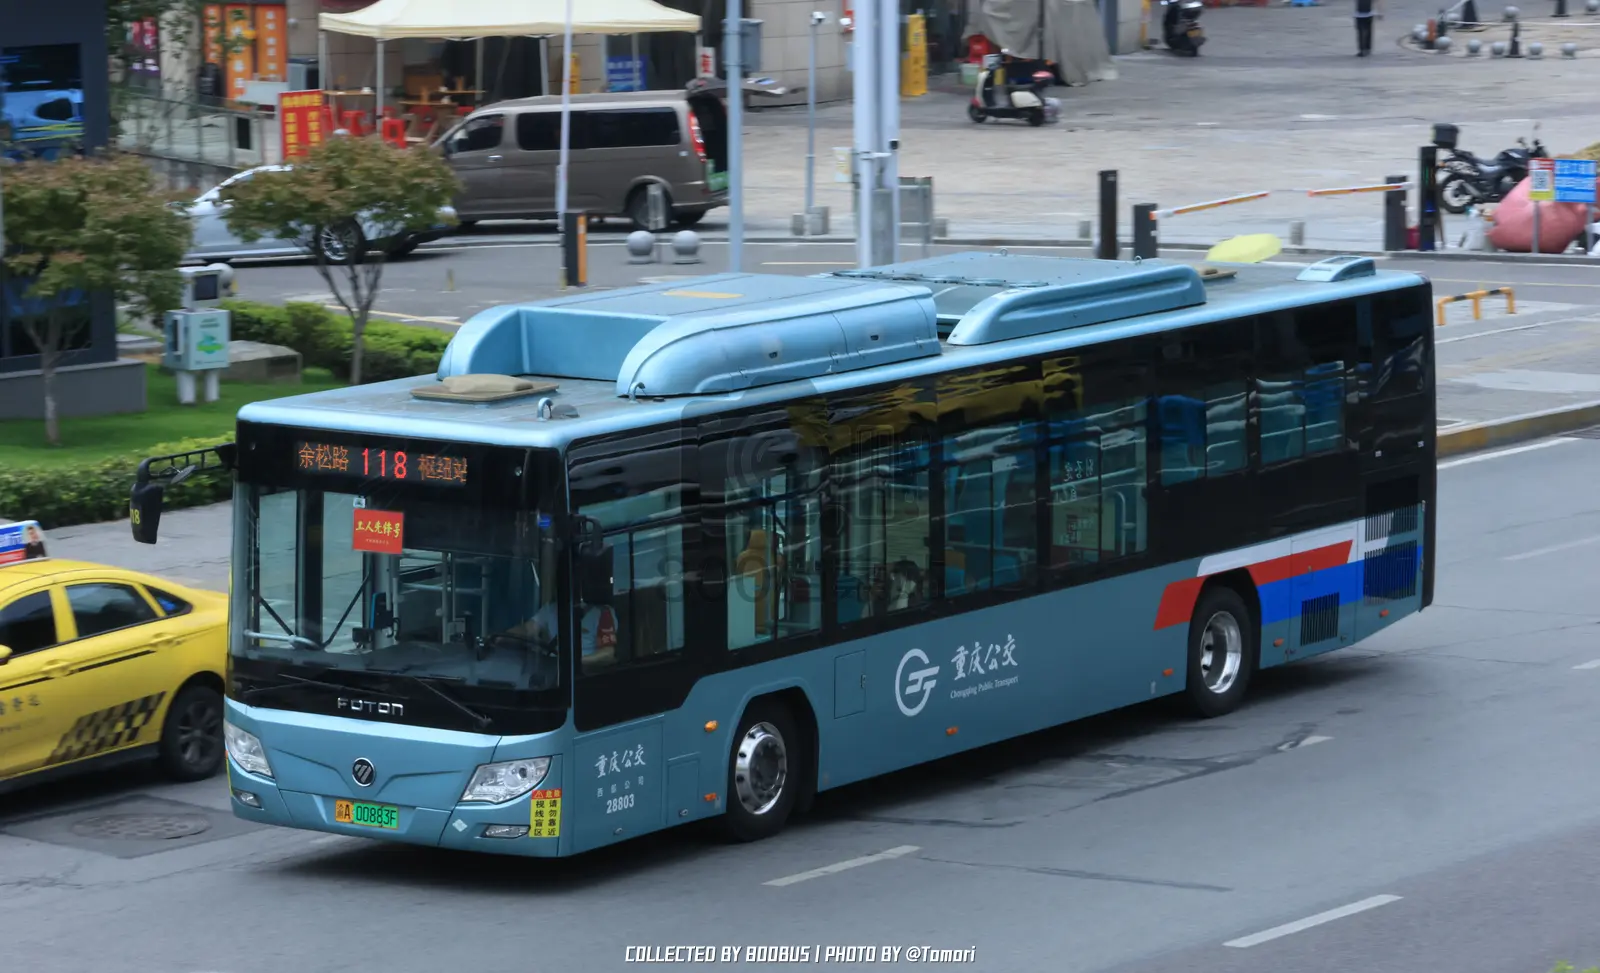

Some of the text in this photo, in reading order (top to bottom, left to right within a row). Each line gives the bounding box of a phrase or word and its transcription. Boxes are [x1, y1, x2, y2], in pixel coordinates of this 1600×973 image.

[298, 442, 468, 482] 余松路 118 枢纽站
[951, 633, 1018, 680] 重庆公交
[337, 697, 404, 716] FOTON
[594, 744, 646, 778] 重庆公交
[606, 793, 635, 814] 28803
